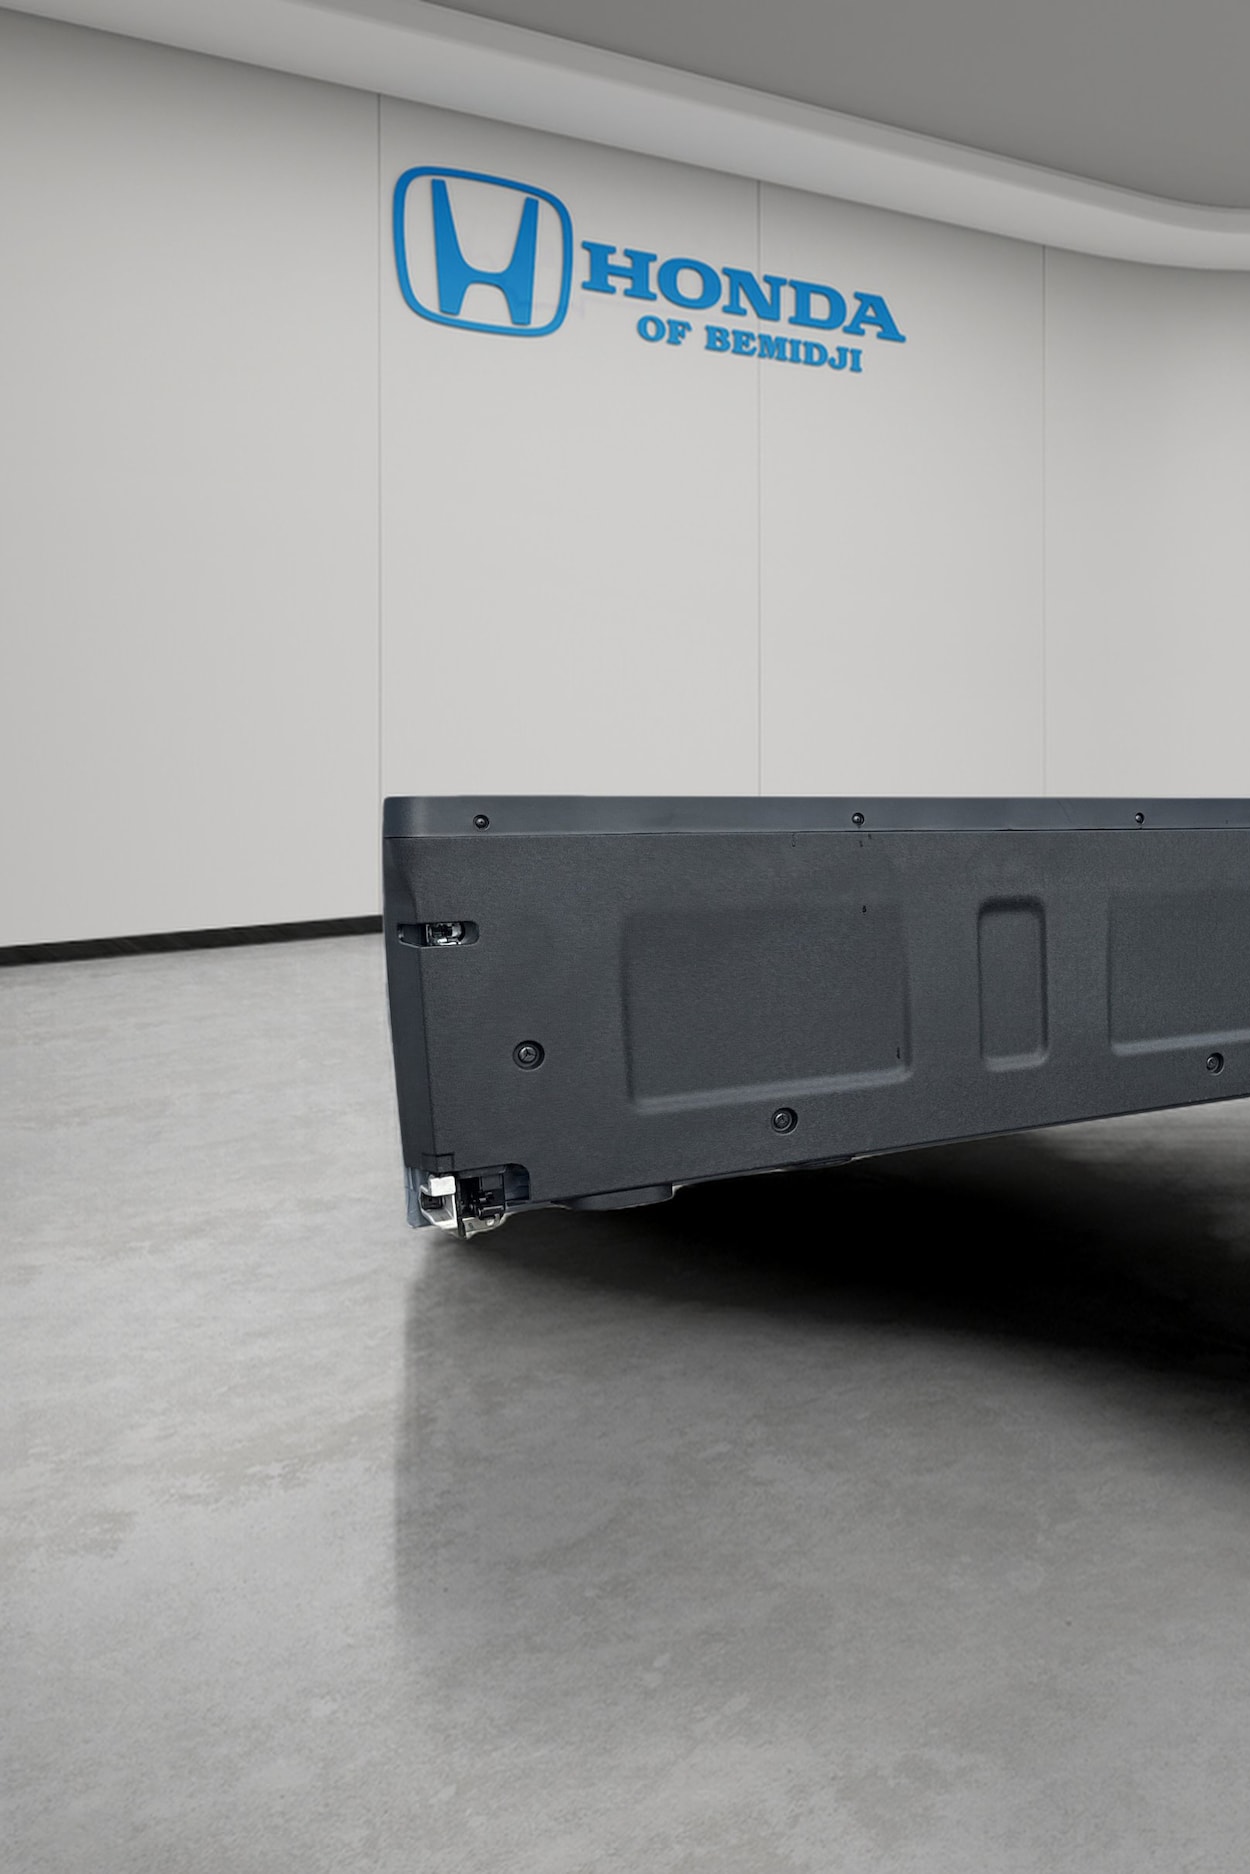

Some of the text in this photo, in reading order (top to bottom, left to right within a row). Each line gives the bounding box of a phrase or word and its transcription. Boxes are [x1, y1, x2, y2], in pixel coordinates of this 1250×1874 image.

[582, 241, 906, 342] HONDA
[637, 314, 862, 373] OF BEMIDJI
